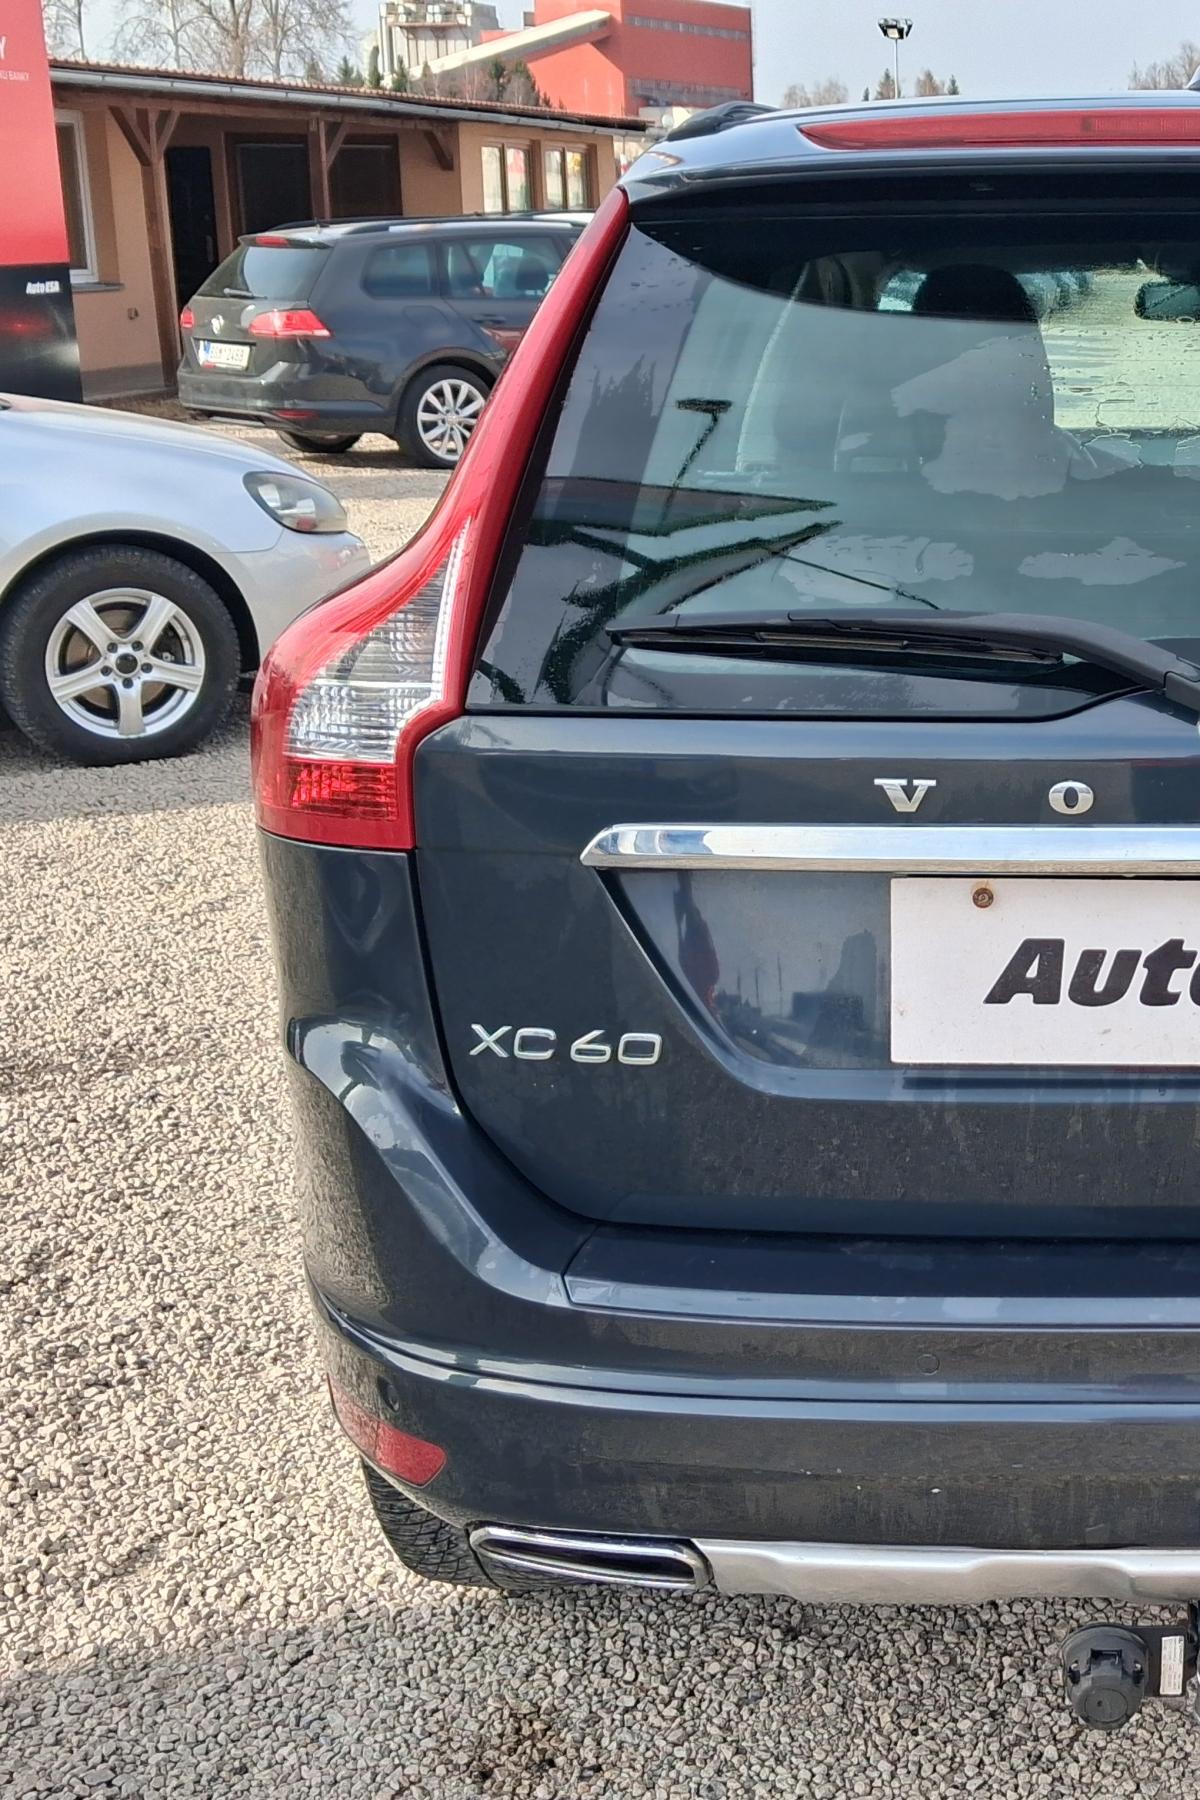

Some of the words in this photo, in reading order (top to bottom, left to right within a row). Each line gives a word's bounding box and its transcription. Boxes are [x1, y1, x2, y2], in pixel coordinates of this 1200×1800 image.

[26, 281, 45, 294] Auto
[45, 280, 60, 293] ESA
[469, 1022, 558, 1061] XC
[569, 1029, 664, 1066] 60
